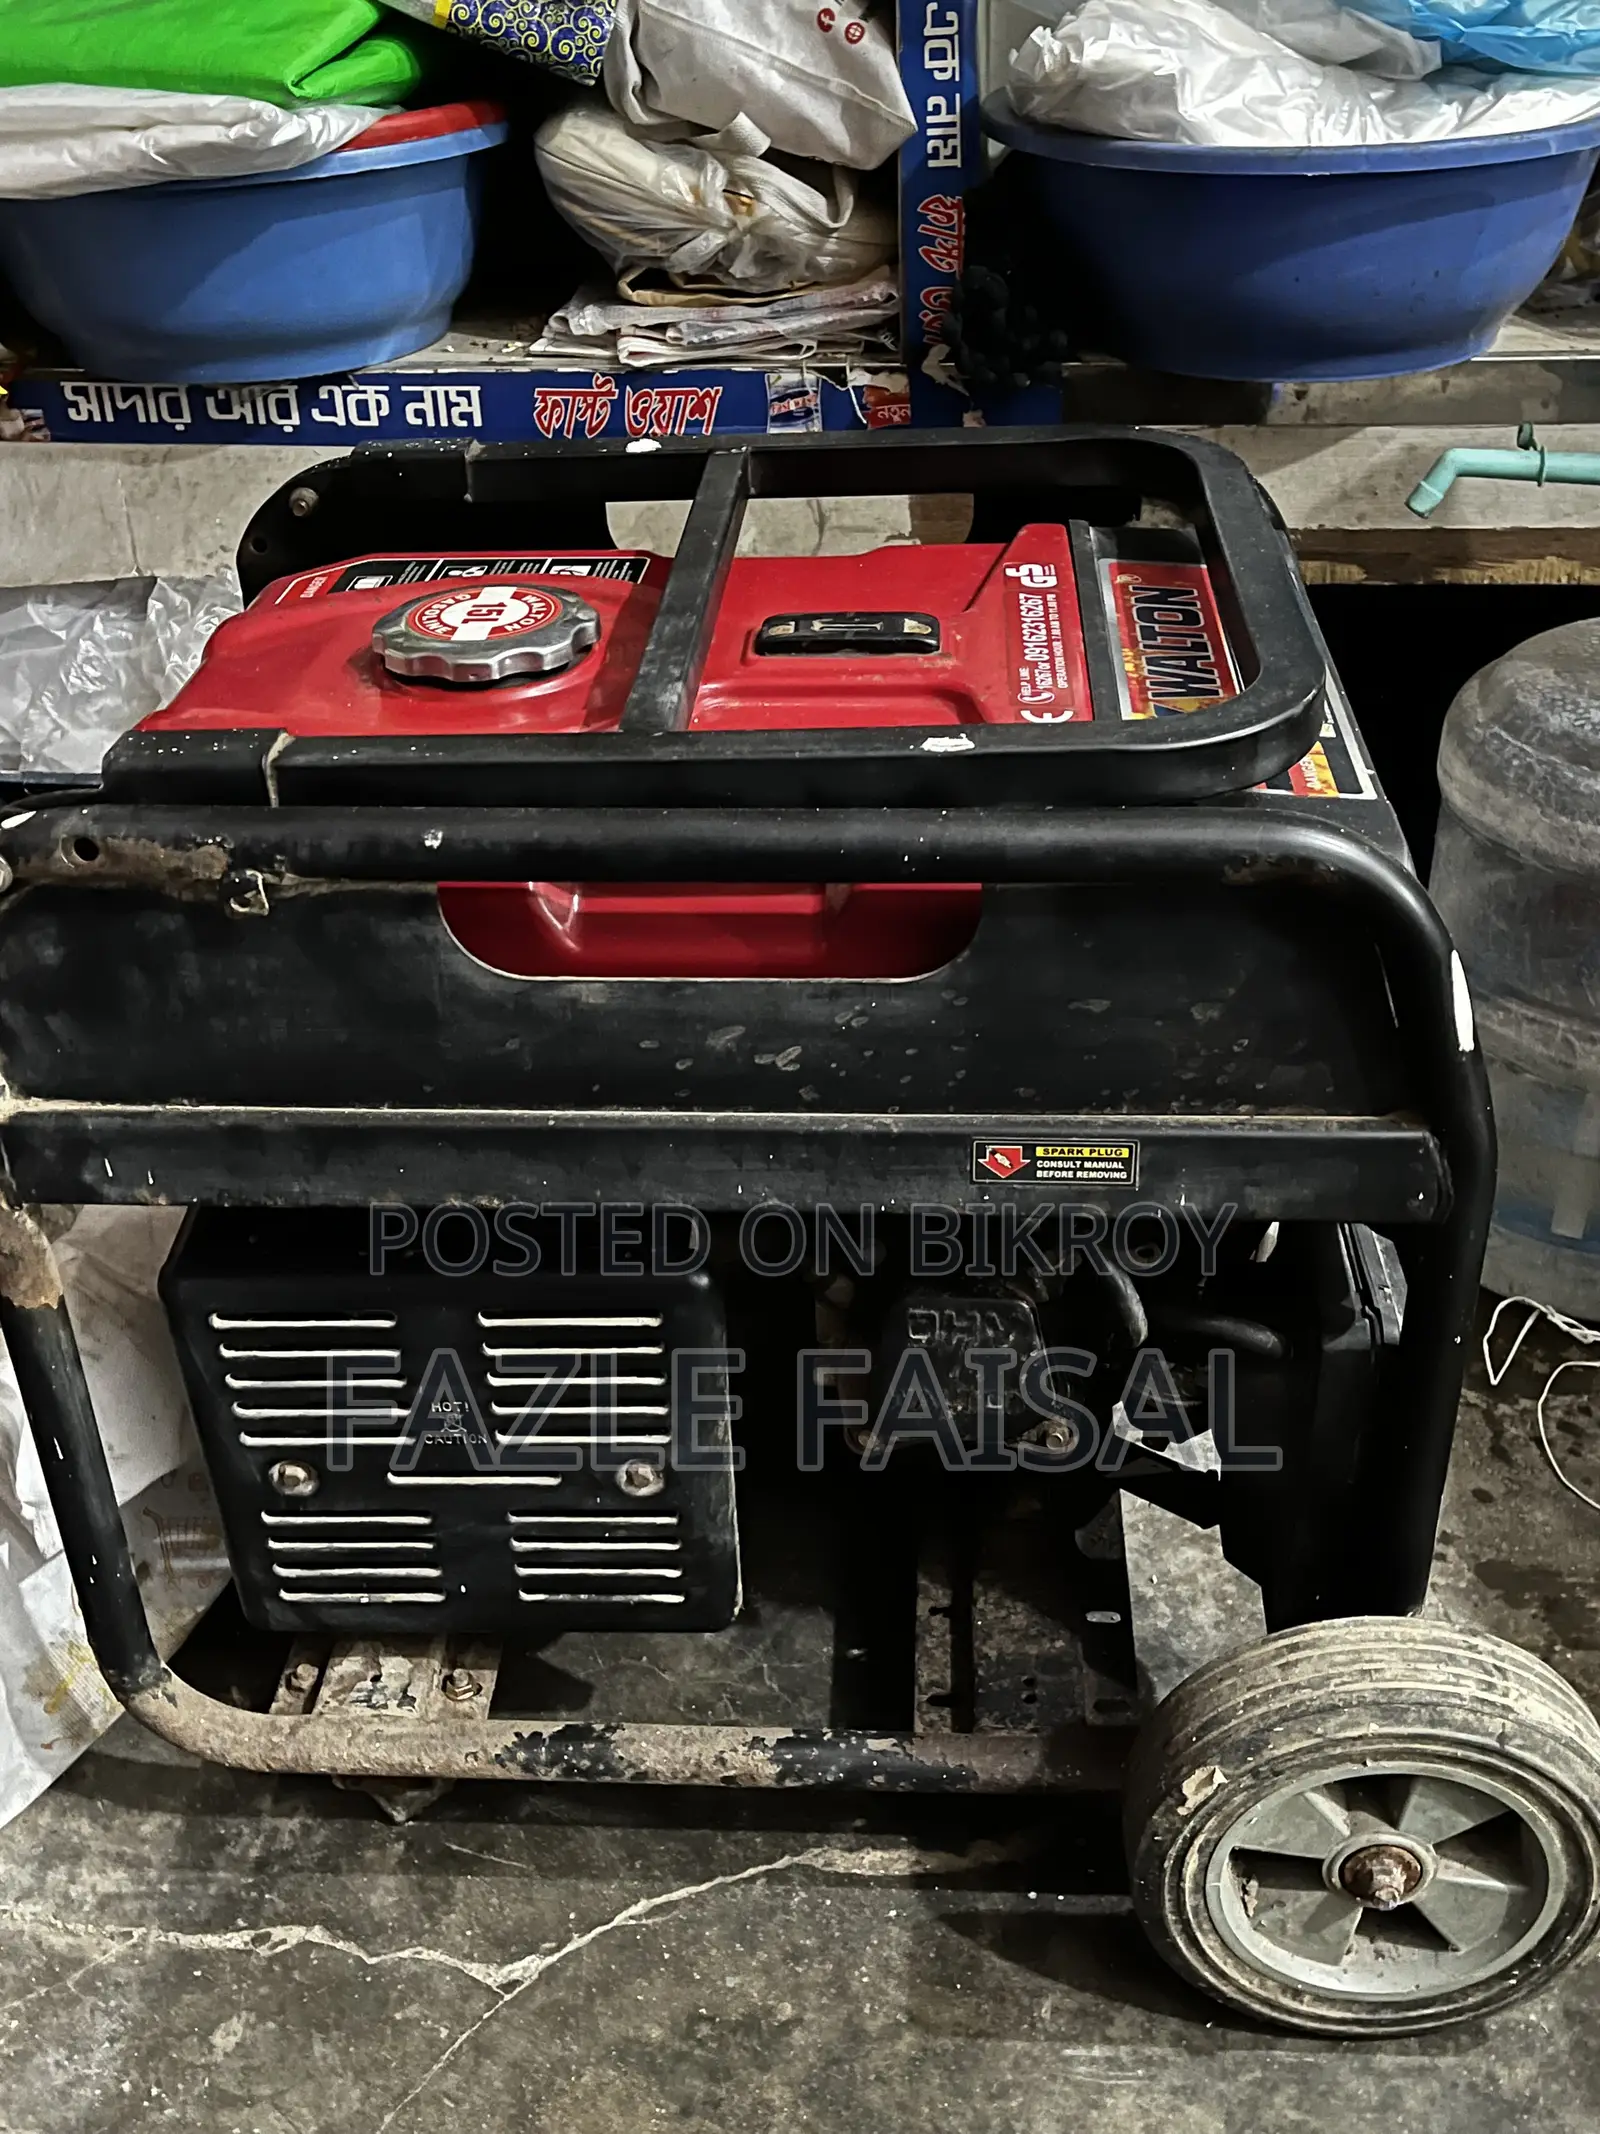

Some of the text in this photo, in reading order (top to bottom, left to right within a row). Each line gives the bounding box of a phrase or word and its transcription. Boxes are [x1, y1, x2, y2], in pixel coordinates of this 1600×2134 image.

[923, 2, 960, 81] এক
[926, 93, 962, 168] নাম
[60, 381, 192, 431] সাদার
[205, 384, 300, 433] আর
[311, 385, 390, 426] এক
[401, 385, 483, 427] নাম
[533, 373, 619, 439] ফাস্ট
[625, 385, 723, 438] ওয়াশ
[422, 593, 472, 635] GASOLINE
[461, 602, 509, 624] 15L
[504, 594, 549, 632] WALTON
[1018, 593, 1051, 661] 09162316267
[1128, 585, 1225, 699] WALTON
[1034, 668, 1053, 689] 16267
[1054, 656, 1069, 688] OPERATION
[1036, 1160, 1125, 1169] CONSULT MANUAL
[1042, 1148, 1123, 1157] SPARK PLUG
[1036, 1170, 1128, 1179] BEFORE REMOVING
[431, 1401, 470, 1412] HOT!
[424, 1433, 488, 1445] CAUTION
